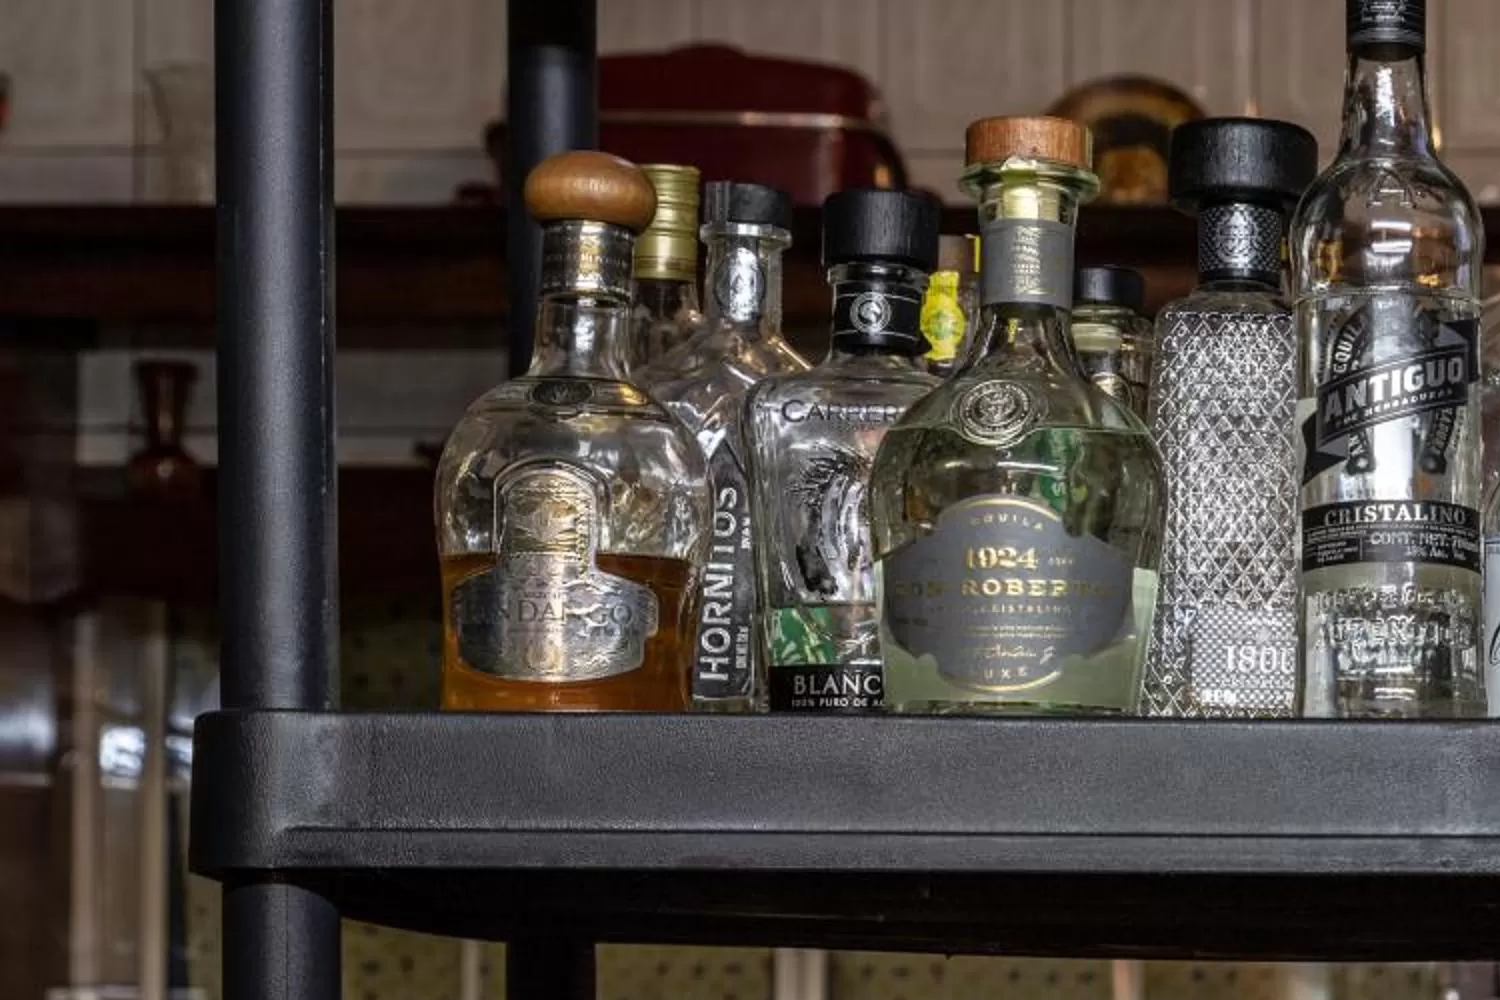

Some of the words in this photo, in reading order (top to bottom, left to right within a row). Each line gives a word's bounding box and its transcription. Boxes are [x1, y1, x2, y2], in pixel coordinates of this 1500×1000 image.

[1324, 355, 1464, 425] ANTIGUO
[781, 401, 899, 423] CARRER
[1324, 503, 1466, 527] CRISTALINO
[700, 487, 738, 681] HORNITOS
[794, 674, 881, 696] BLANC
